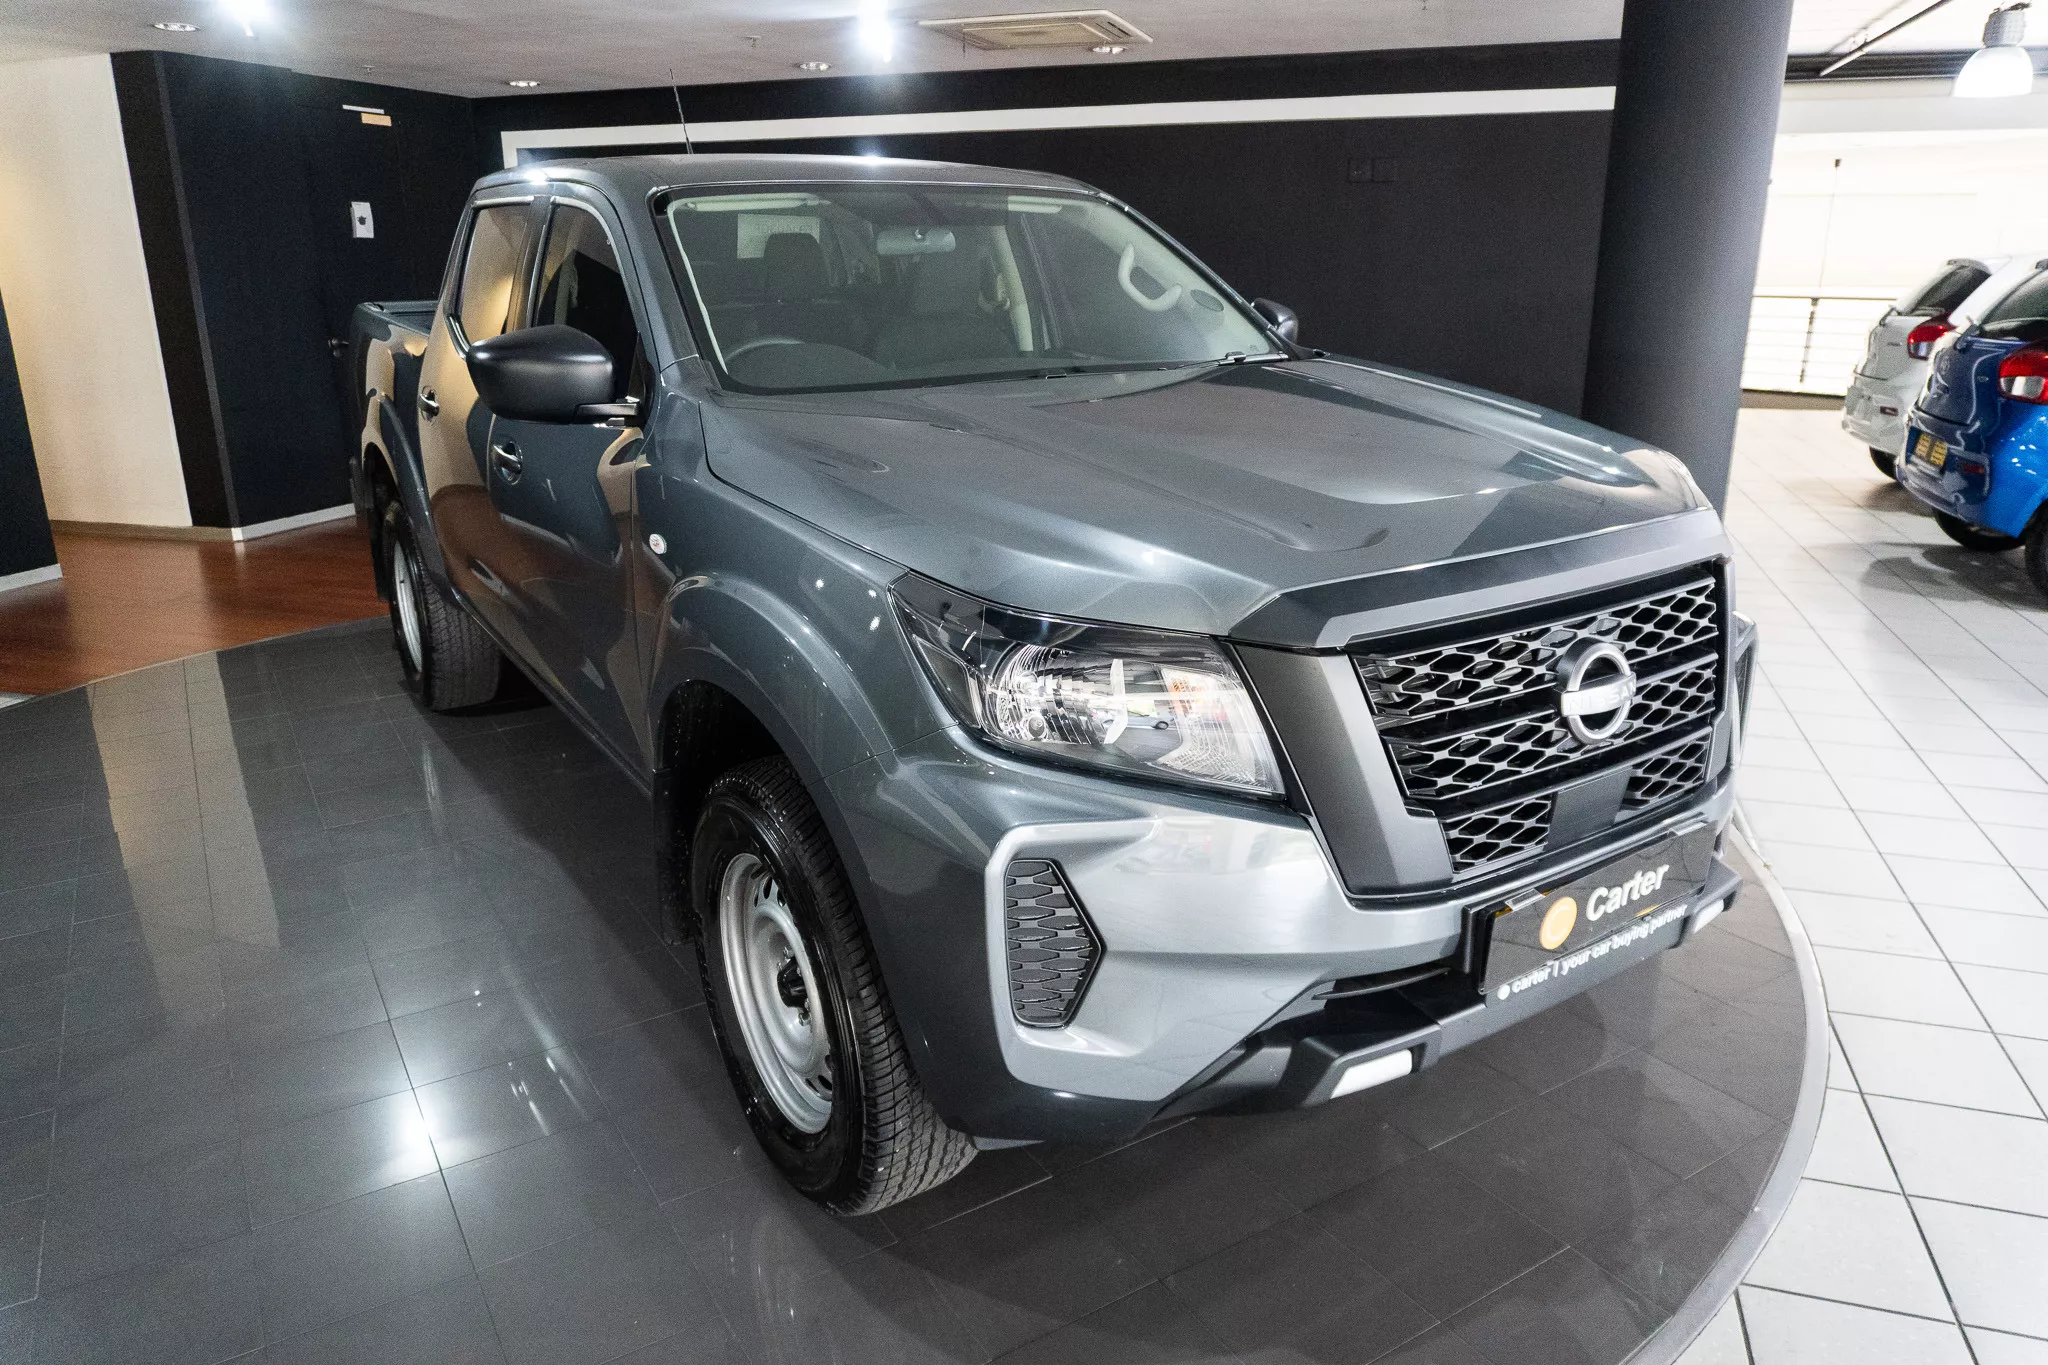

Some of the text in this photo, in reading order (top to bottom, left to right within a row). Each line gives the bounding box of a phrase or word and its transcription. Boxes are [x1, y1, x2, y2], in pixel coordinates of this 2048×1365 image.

[1568, 679, 1636, 710] NISSAN
[1585, 864, 1670, 921] Carter
[1511, 966, 1551, 994] carter
[1561, 950, 1591, 975] your
[1592, 941, 1612, 959] car
[1612, 926, 1648, 950] buying
[1649, 904, 1688, 934] partner
